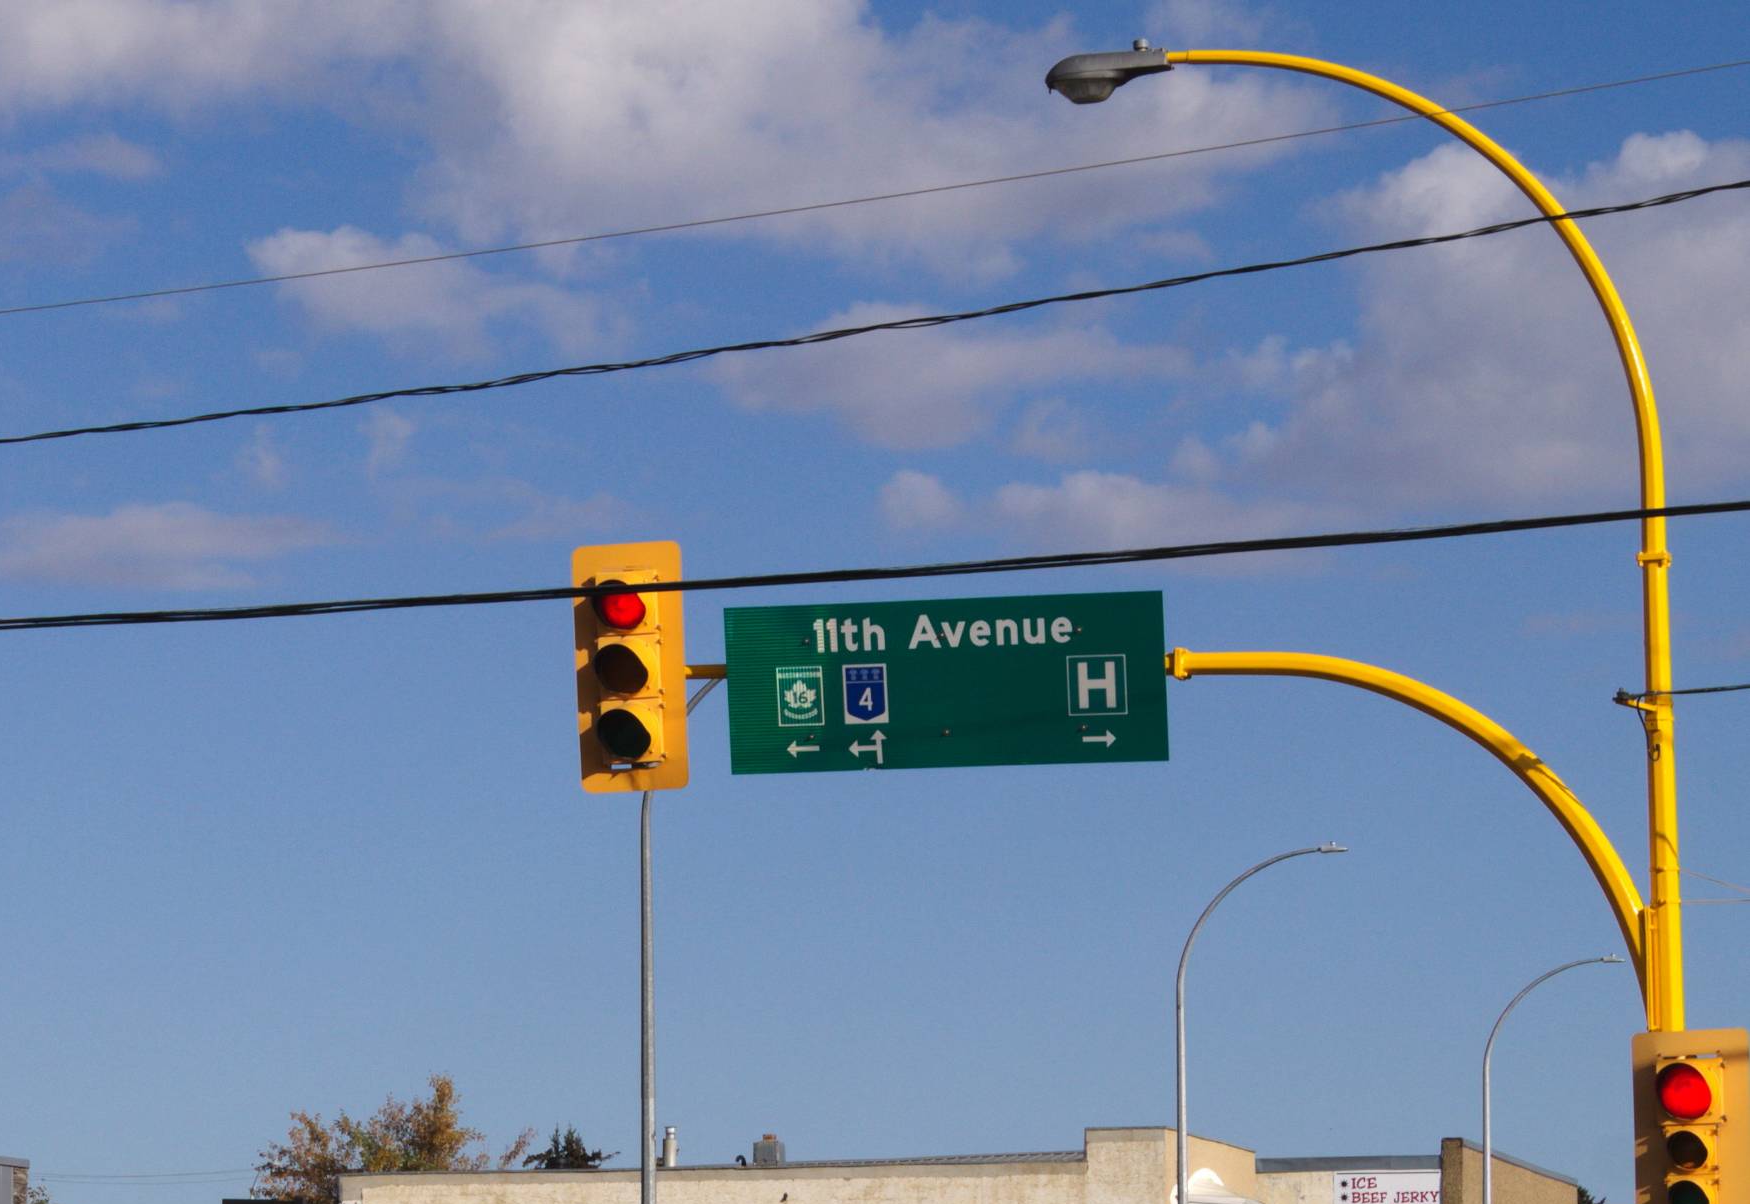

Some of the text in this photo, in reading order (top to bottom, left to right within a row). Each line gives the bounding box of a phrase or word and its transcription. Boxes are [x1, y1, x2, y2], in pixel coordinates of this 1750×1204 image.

[812, 614, 1074, 654] 11th Avenue
[1076, 660, 1117, 709] H
[792, 691, 809, 704] 16
[858, 687, 874, 711] 4
[1351, 1177, 1378, 1190] ICE
[1351, 1190, 1439, 1204] BEEF JERKY
